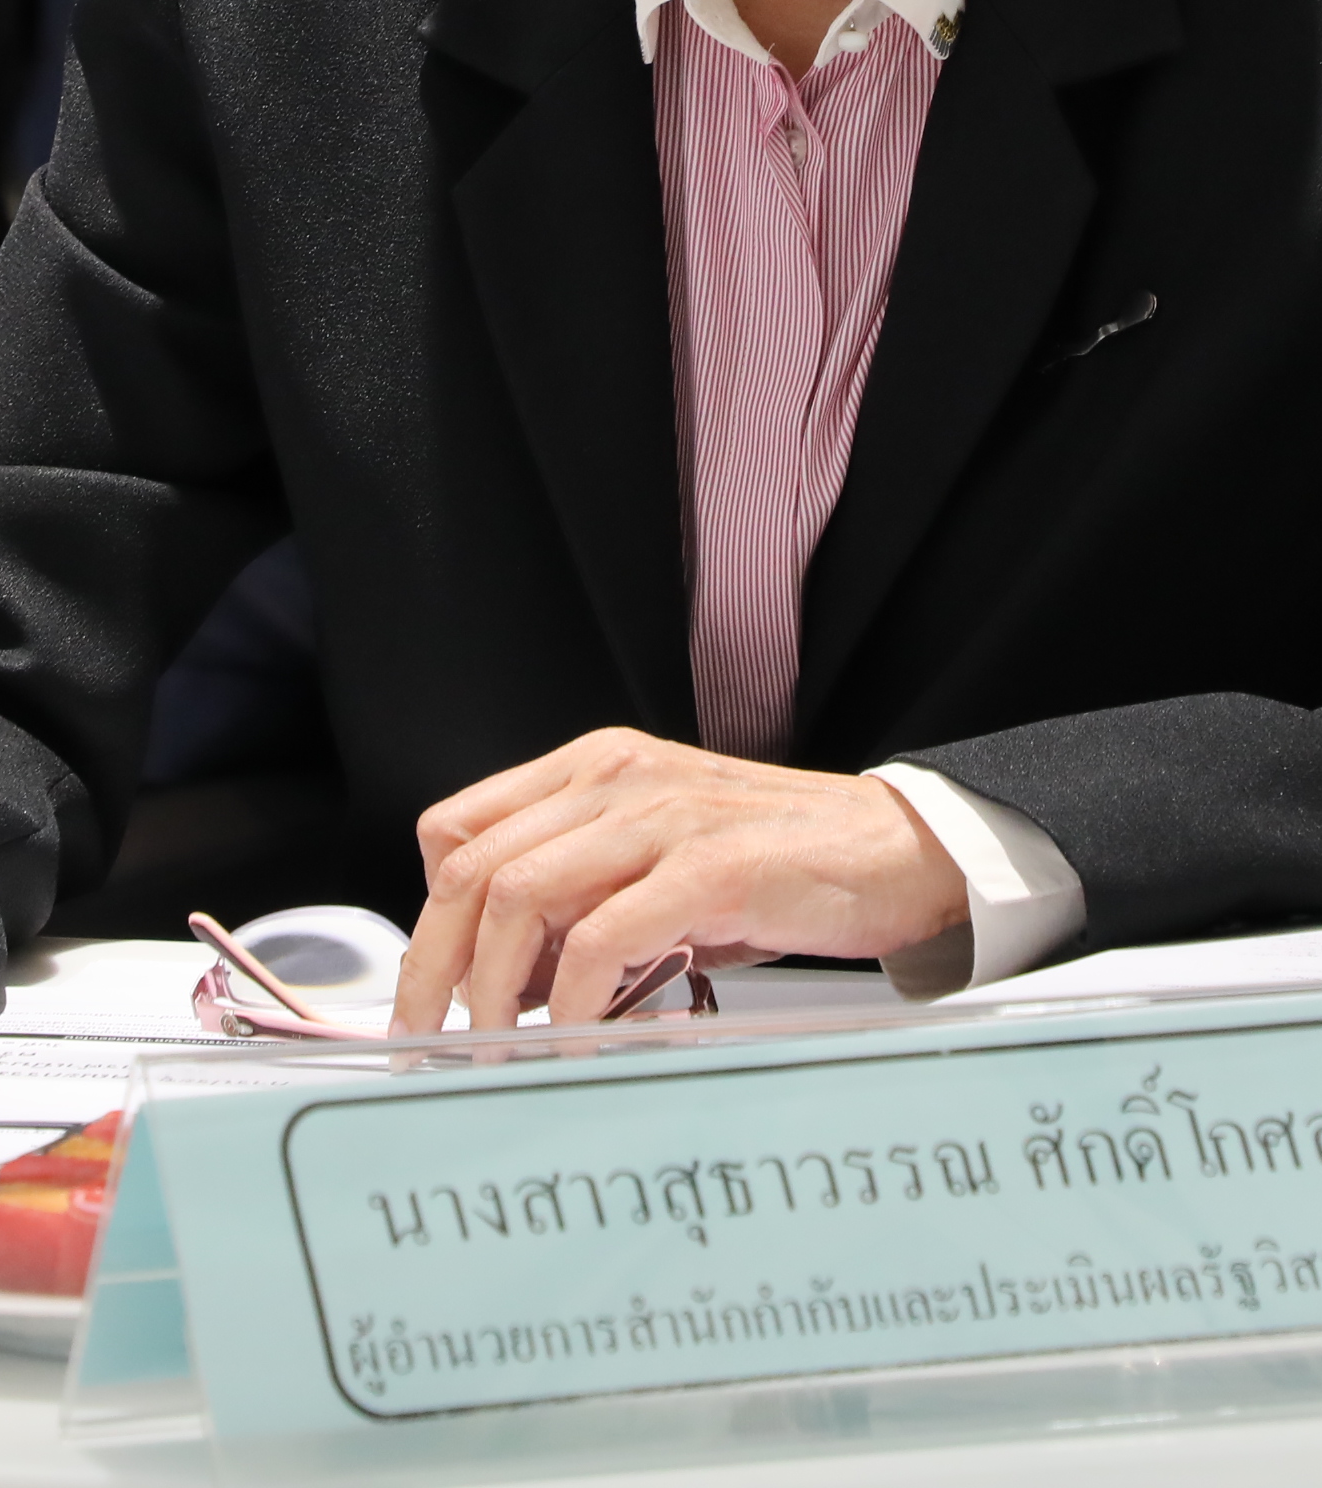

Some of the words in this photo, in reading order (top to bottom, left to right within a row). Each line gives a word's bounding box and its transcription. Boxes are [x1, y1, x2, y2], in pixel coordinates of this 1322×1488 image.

[369, 1135, 1001, 1249] นางสาวสุธาวรรณ
